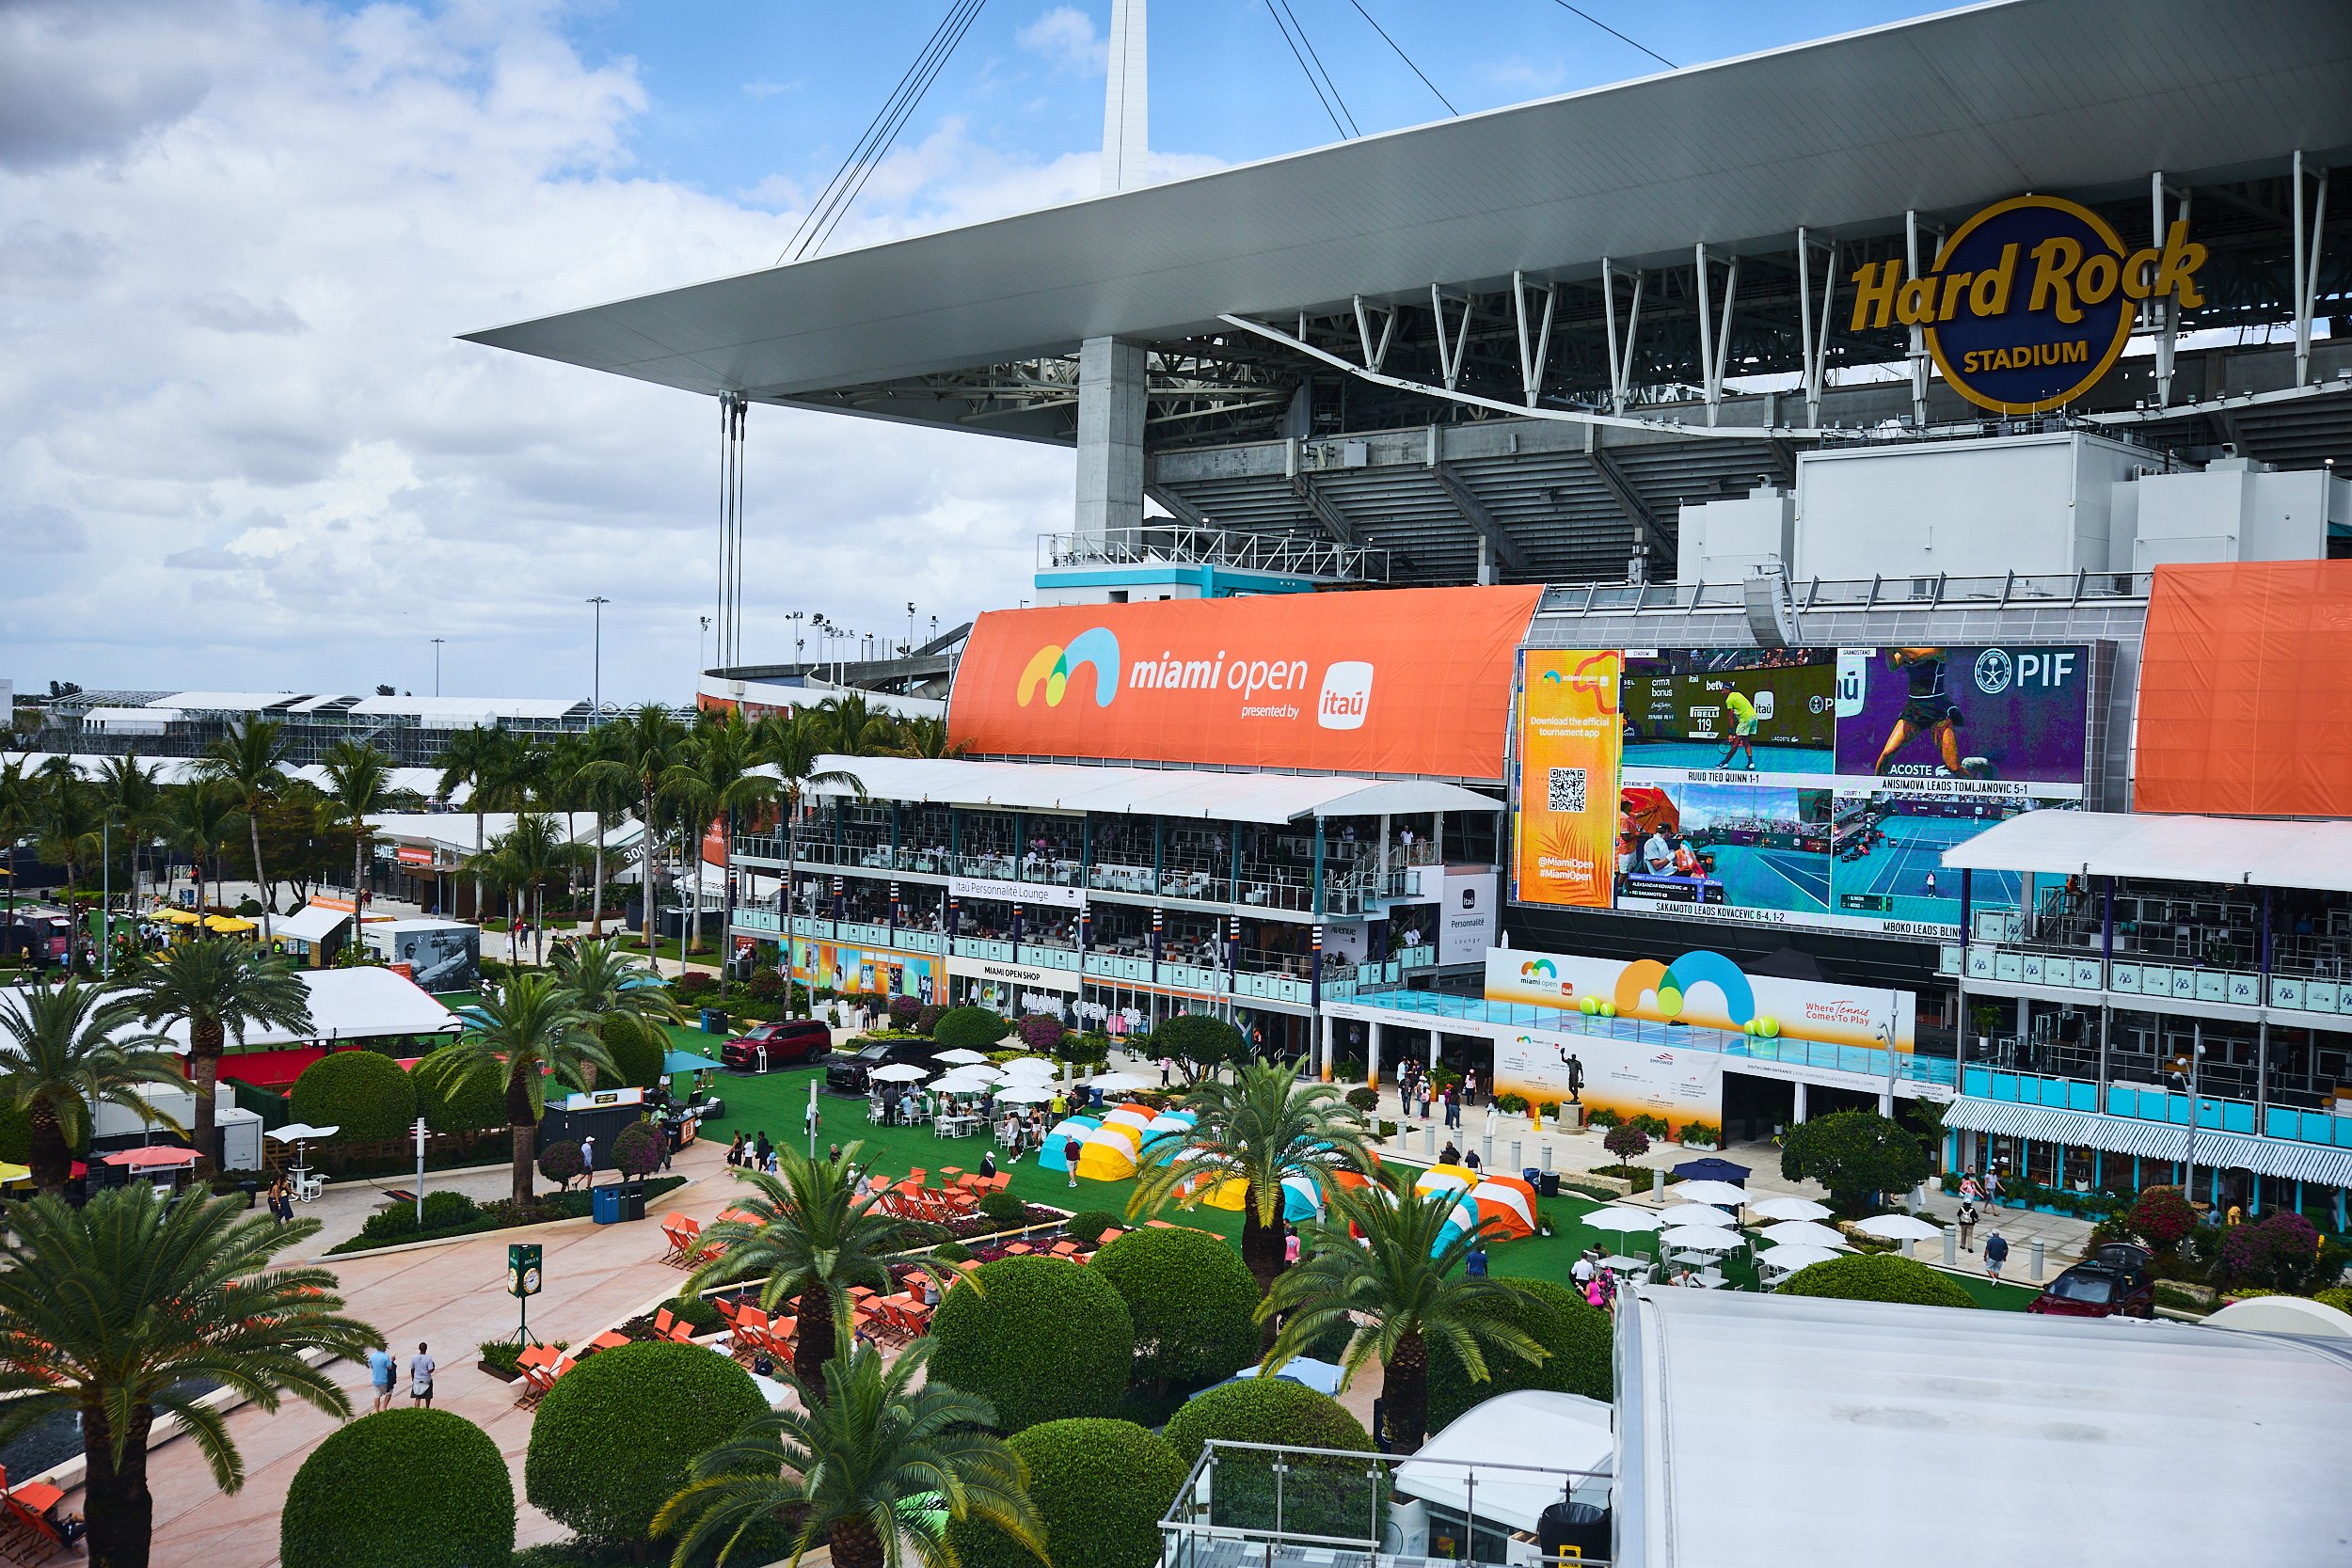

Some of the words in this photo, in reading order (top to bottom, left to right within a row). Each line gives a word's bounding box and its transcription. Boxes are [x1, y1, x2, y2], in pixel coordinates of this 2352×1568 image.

[1850, 243, 2022, 331] Hard
[2028, 219, 2209, 324] Rock
[1963, 340, 2089, 373] STADIUM
[1129, 649, 1226, 689] miami
[1228, 659, 1308, 701] open
[2017, 653, 2075, 687] PIF
[1652, 688, 1673, 697] bonus
[1323, 689, 1364, 715] itaú
[1756, 704, 1772, 714] itaú
[1241, 704, 1280, 720] presented
[1282, 705, 1299, 721] by
[1690, 705, 1721, 718] PIRELLI
[1531, 716, 1568, 726] Download
[1569, 717, 1581, 726] the
[1582, 718, 1609, 726] official
[1697, 718, 1712, 731] 119
[1539, 728, 1583, 737] tournament
[1585, 729, 1600, 738] app
[1689, 771, 1707, 782] RUUD
[1708, 772, 1724, 783] TIED
[1725, 772, 1747, 784] QUINN
[1749, 774, 1759, 784] 1-1
[1888, 765, 1932, 776] ACOSTE
[1883, 779, 1925, 790] ANISIMOVA
[1927, 781, 1951, 791] LEADS
[1955, 782, 2011, 794] TOMLJANOVIC
[2014, 784, 2027, 795] 5-1
[1538, 856, 1594, 870] @MiamiOpen
[1539, 868, 1592, 881] #MiamiOpen
[956, 880, 970, 895] Itaú
[971, 882, 1018, 898] Personnalité
[1019, 887, 1049, 901] Lounge
[1463, 896, 1474, 906] itaú
[1656, 903, 1692, 914] SAKAMOTO
[1694, 905, 1716, 916] LEADS
[1717, 908, 1755, 920] KOVACEVIC
[1756, 911, 1772, 923] 6-4,
[1773, 912, 1785, 922] 1-2
[1451, 918, 1485, 928] Personnalité
[1883, 921, 1911, 933] MBOKO
[1913, 924, 1938, 935] LEADS
[984, 966, 1005, 975] MIAMI
[1005, 969, 1023, 979] OPEN
[1024, 971, 1041, 981] SHOP
[1520, 977, 1540, 986] miami
[1021, 992, 1062, 1015] MIAMI
[1072, 999, 1107, 1021] OPEN
[1805, 1003, 1834, 1013] Where
[1831, 1001, 1870, 1018] Tennis
[1806, 1011, 1836, 1022] Comes
[1837, 1015, 1849, 1023] To
[1851, 1016, 1869, 1027] Play
[525, 1257, 540, 1265] ROLEX
